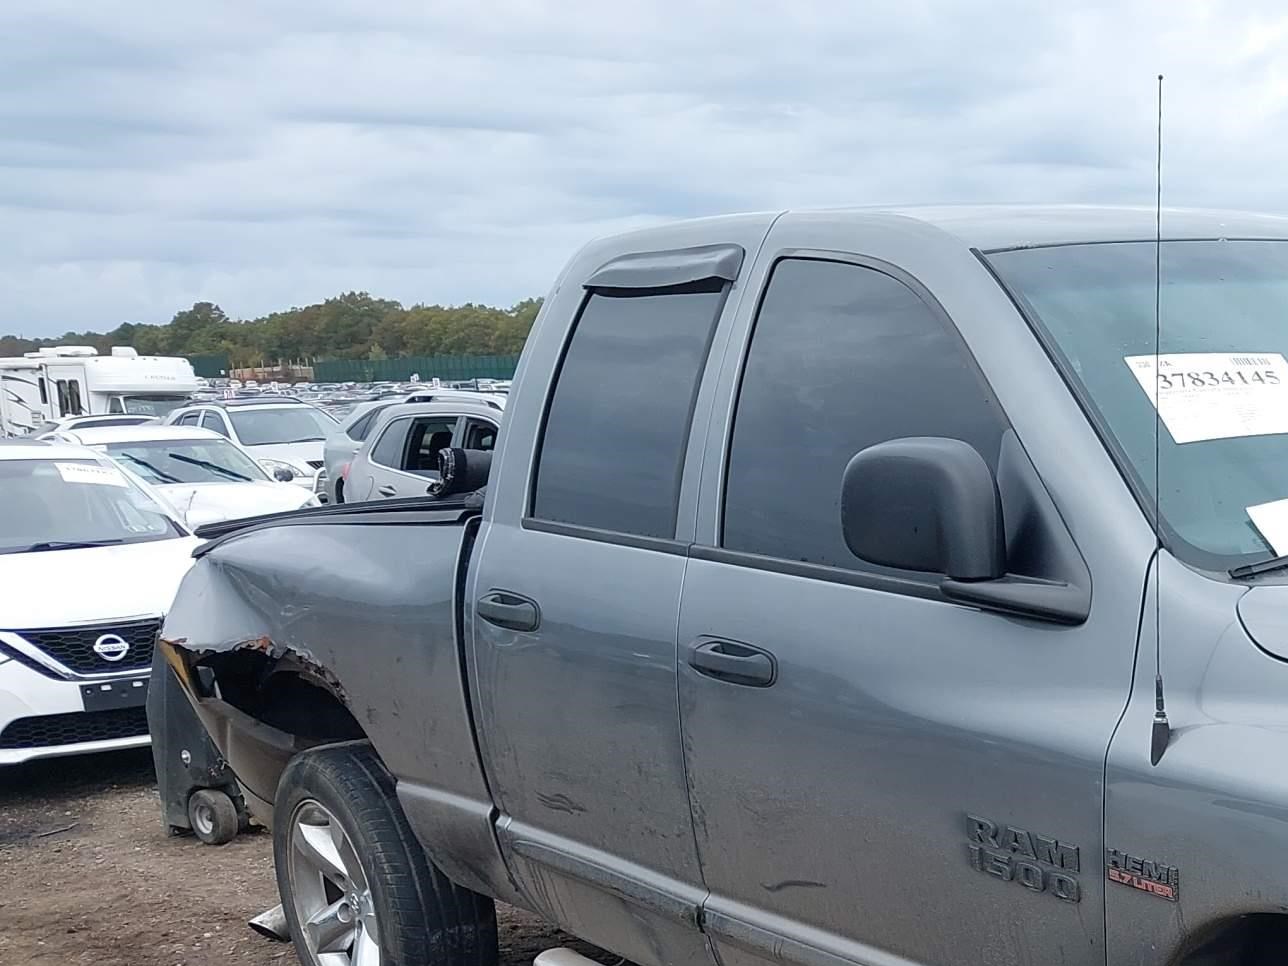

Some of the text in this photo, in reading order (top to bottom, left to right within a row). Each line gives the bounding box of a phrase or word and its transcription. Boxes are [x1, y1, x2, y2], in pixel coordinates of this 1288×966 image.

[1157, 370, 1281, 390] 37834145
[967, 814, 1081, 874] RAM
[968, 843, 1082, 904] 1500
[1106, 848, 1180, 885] HEMI
[1132, 878, 1175, 899] LITER
